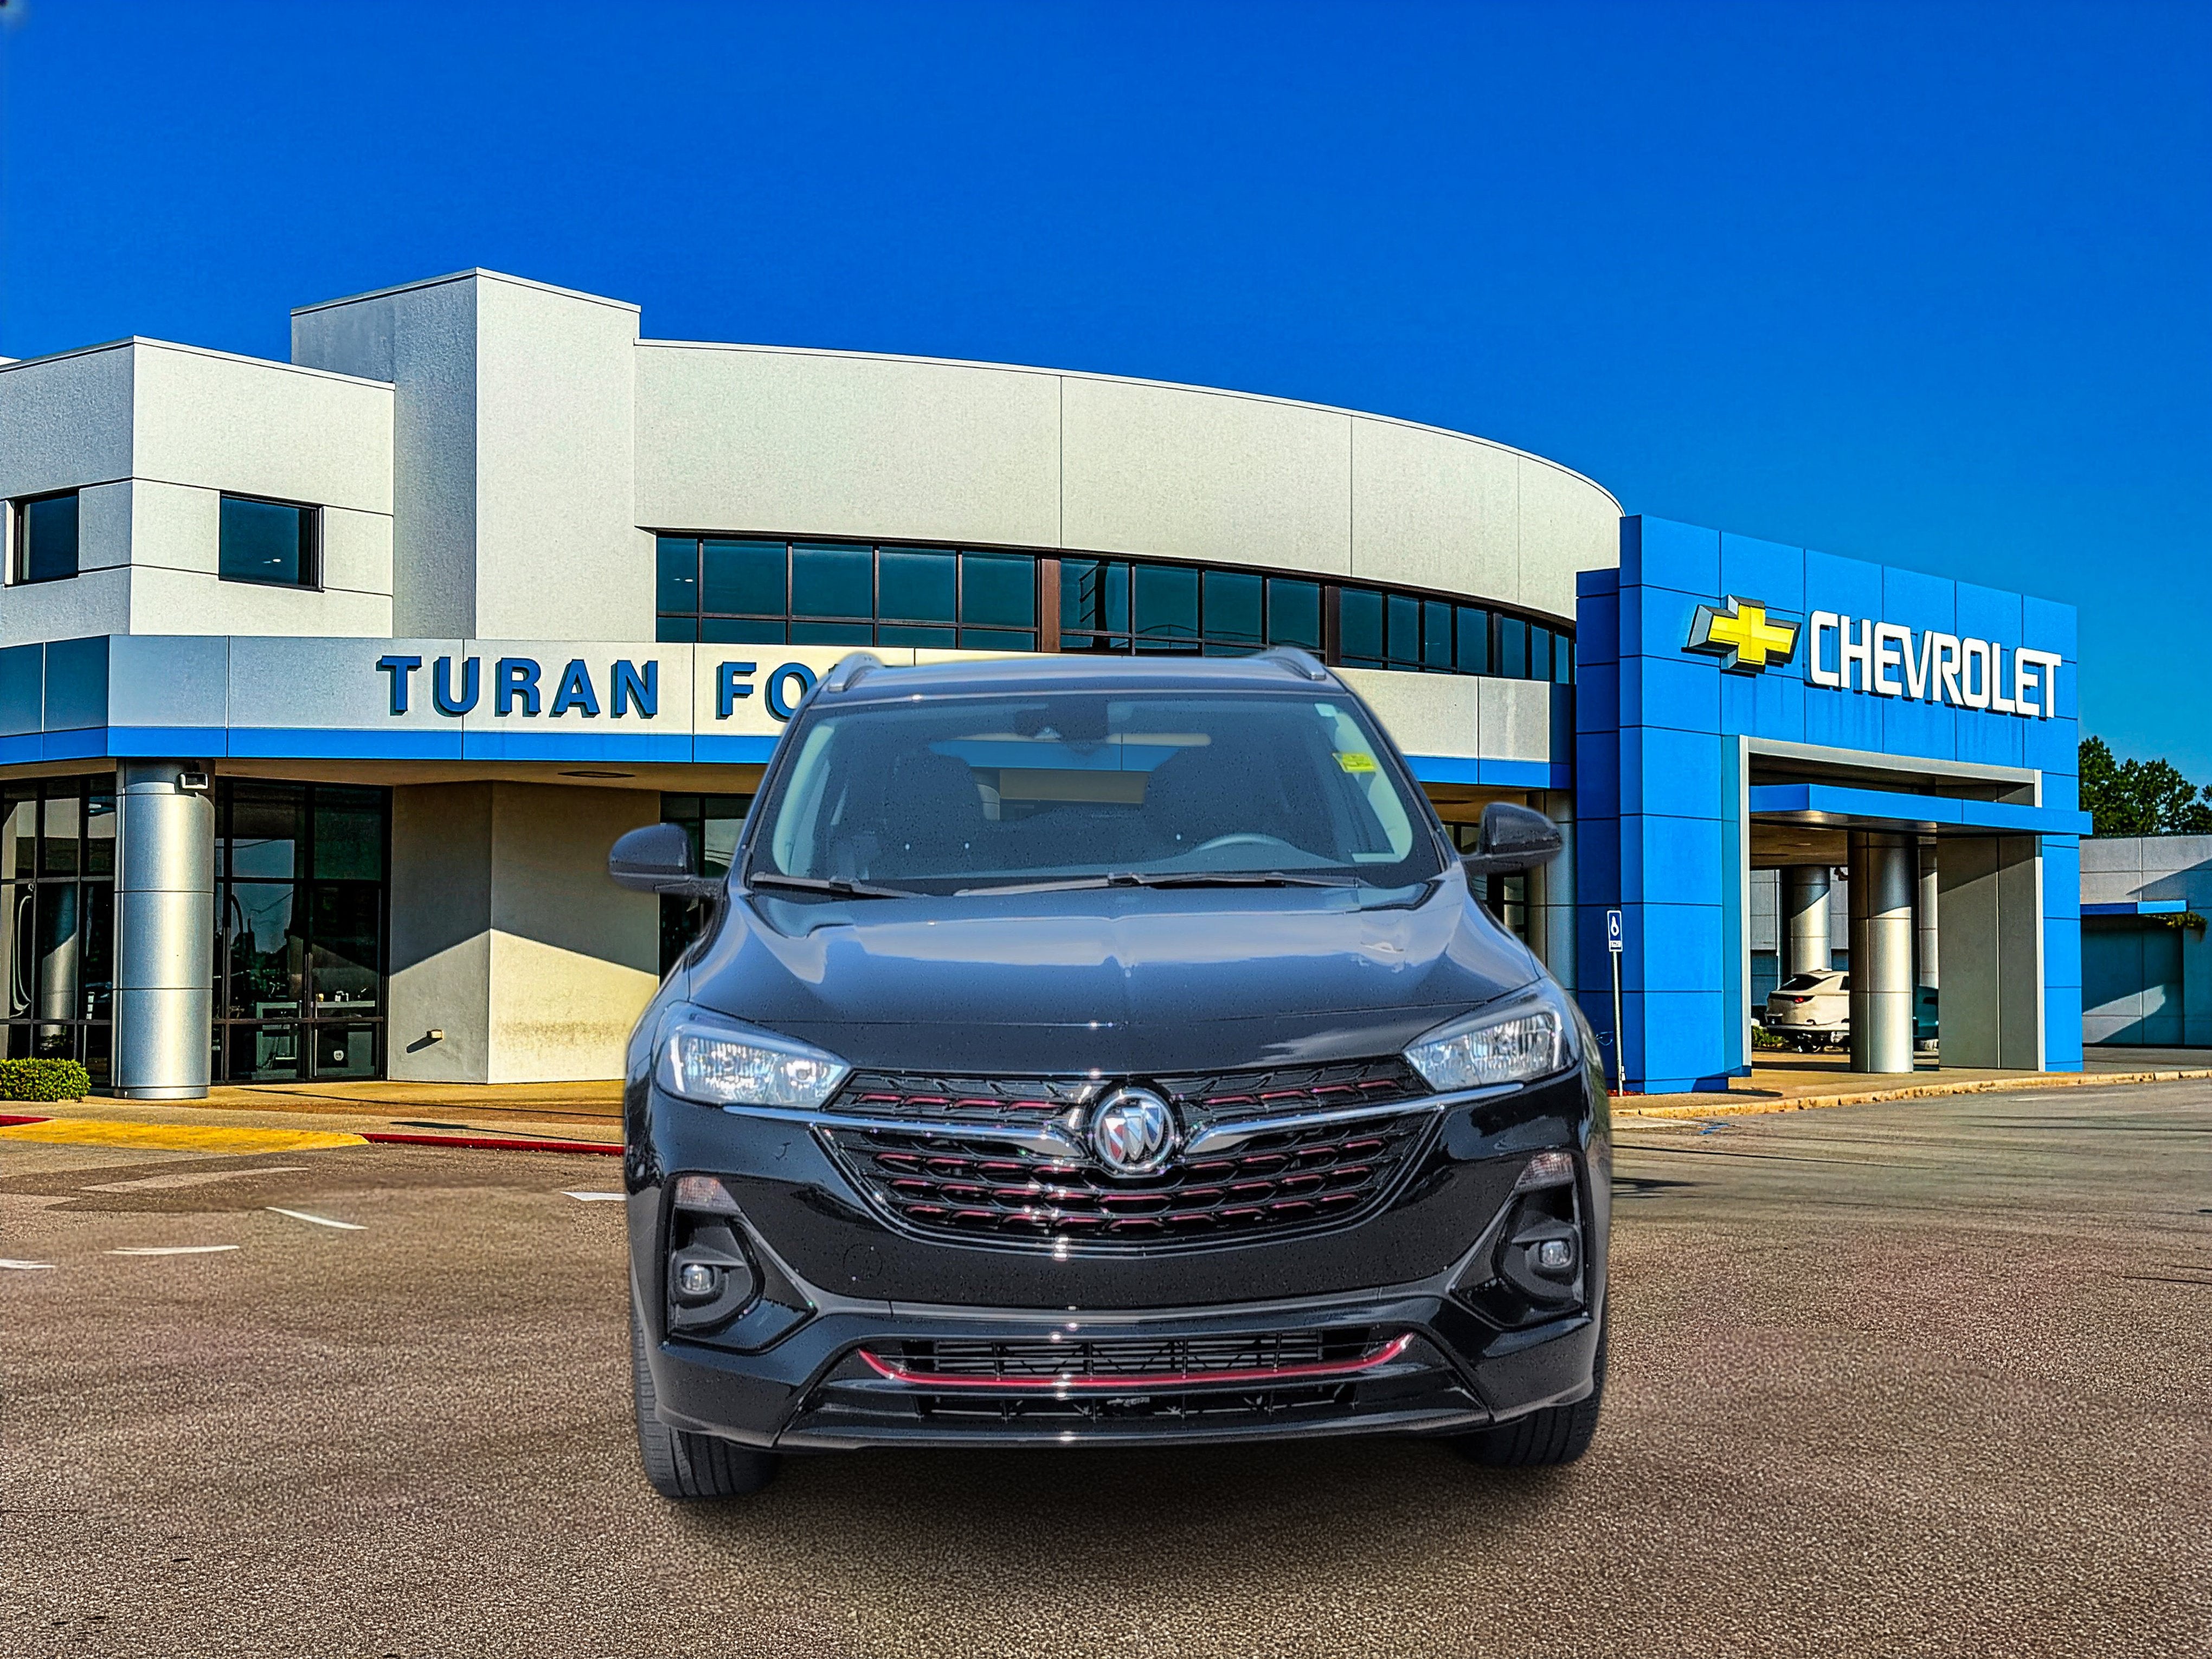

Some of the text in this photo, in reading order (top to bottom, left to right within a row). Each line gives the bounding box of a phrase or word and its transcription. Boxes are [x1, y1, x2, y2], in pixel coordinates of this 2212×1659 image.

[376, 655, 837, 723] TURAN FO
[1809, 609, 2062, 719] CHEVROLET
